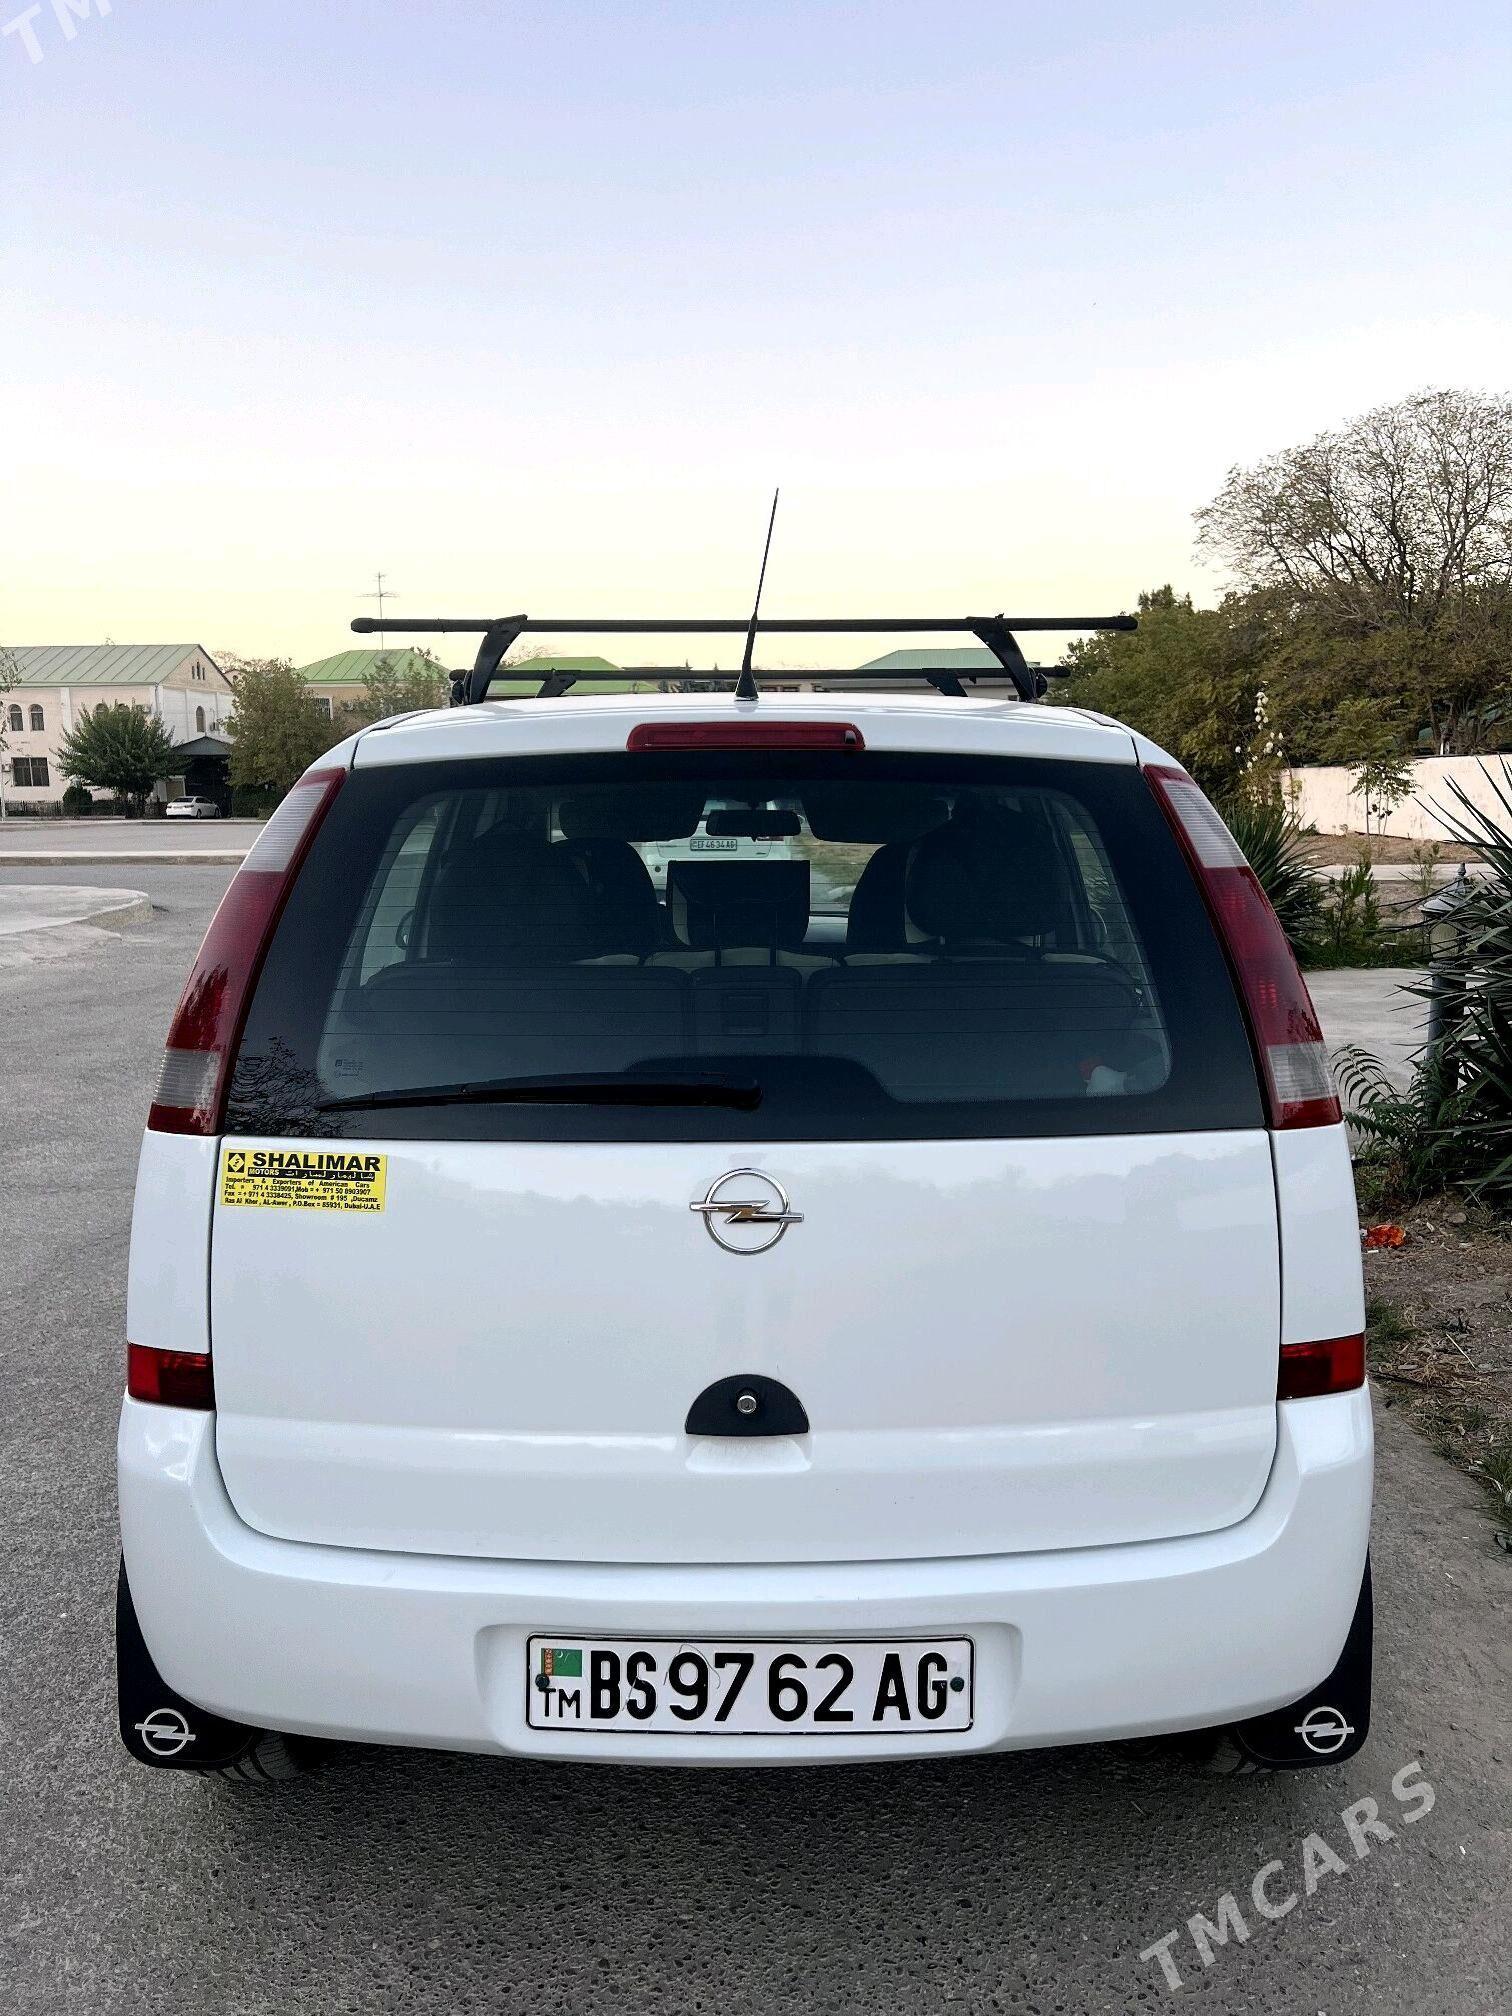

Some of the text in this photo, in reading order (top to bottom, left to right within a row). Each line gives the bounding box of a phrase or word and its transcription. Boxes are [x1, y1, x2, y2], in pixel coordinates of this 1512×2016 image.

[253, 1152, 380, 1171] SHALIMAR
[226, 1177, 254, 1185] Importers
[248, 1168, 280, 1176] MOTORS
[590, 1650, 657, 1720] BS
[872, 1652, 950, 1721] AG
[539, 1688, 581, 1719] TM
